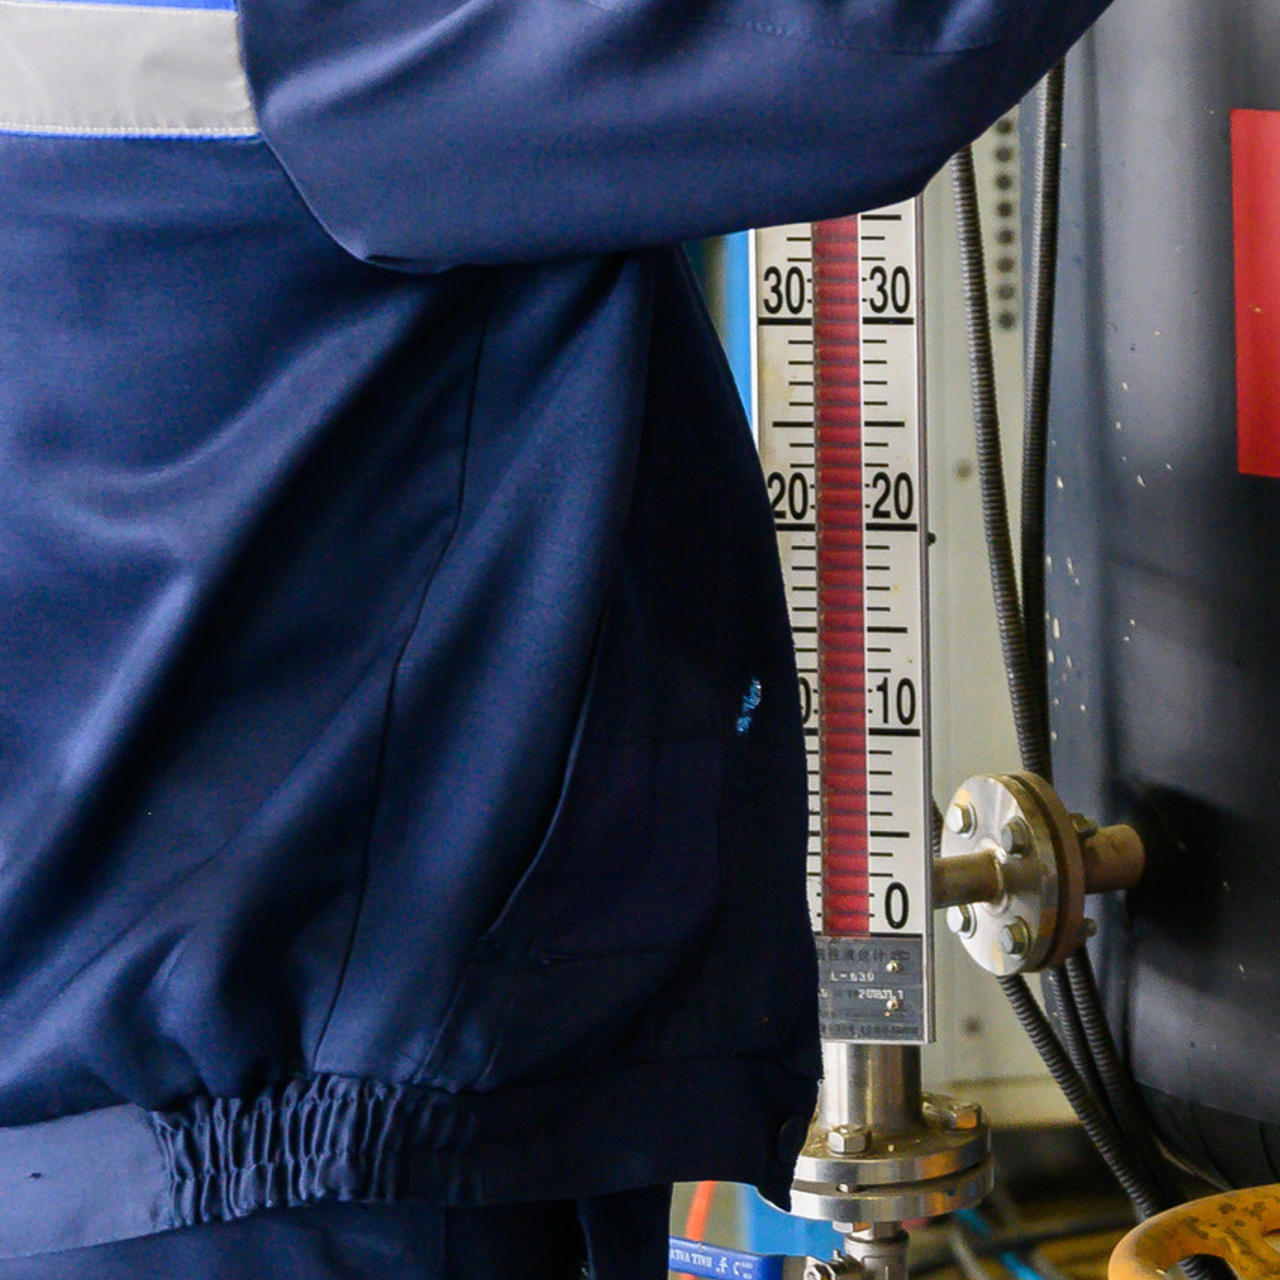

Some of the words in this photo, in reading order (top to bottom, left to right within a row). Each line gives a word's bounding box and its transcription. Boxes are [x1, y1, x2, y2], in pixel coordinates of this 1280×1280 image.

[763, 266, 805, 314] 30
[869, 265, 911, 313] 30
[767, 472, 808, 520] 20
[872, 472, 914, 520] 20
[876, 677, 916, 725] 10
[884, 881, 910, 930] 0
